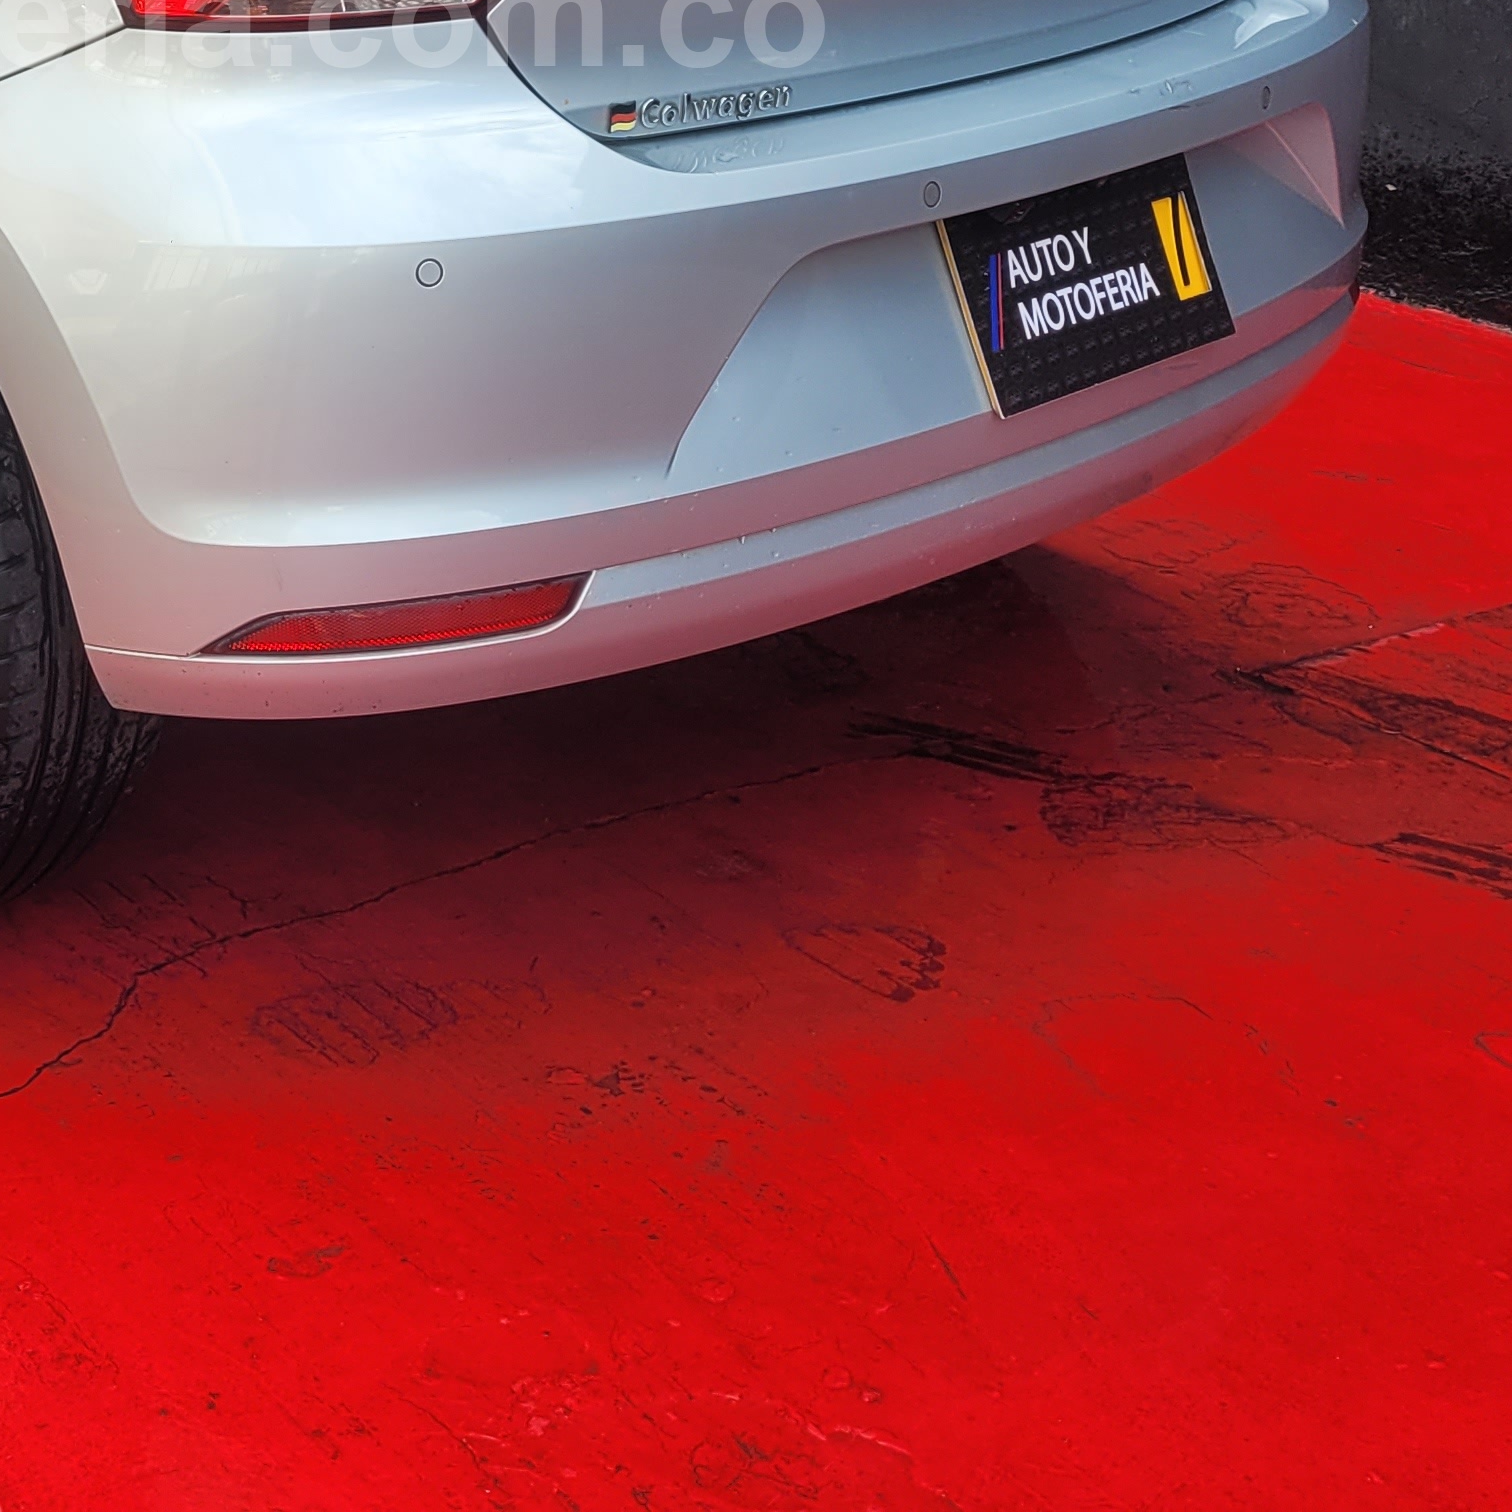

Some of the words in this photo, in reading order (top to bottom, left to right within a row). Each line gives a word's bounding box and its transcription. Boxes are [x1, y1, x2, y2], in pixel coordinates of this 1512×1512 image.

[640, 84, 793, 129] Colwagen
[1006, 233, 1076, 289] AUTO
[1072, 226, 1092, 265] Y
[1017, 262, 1161, 340] MOTOFERIA
